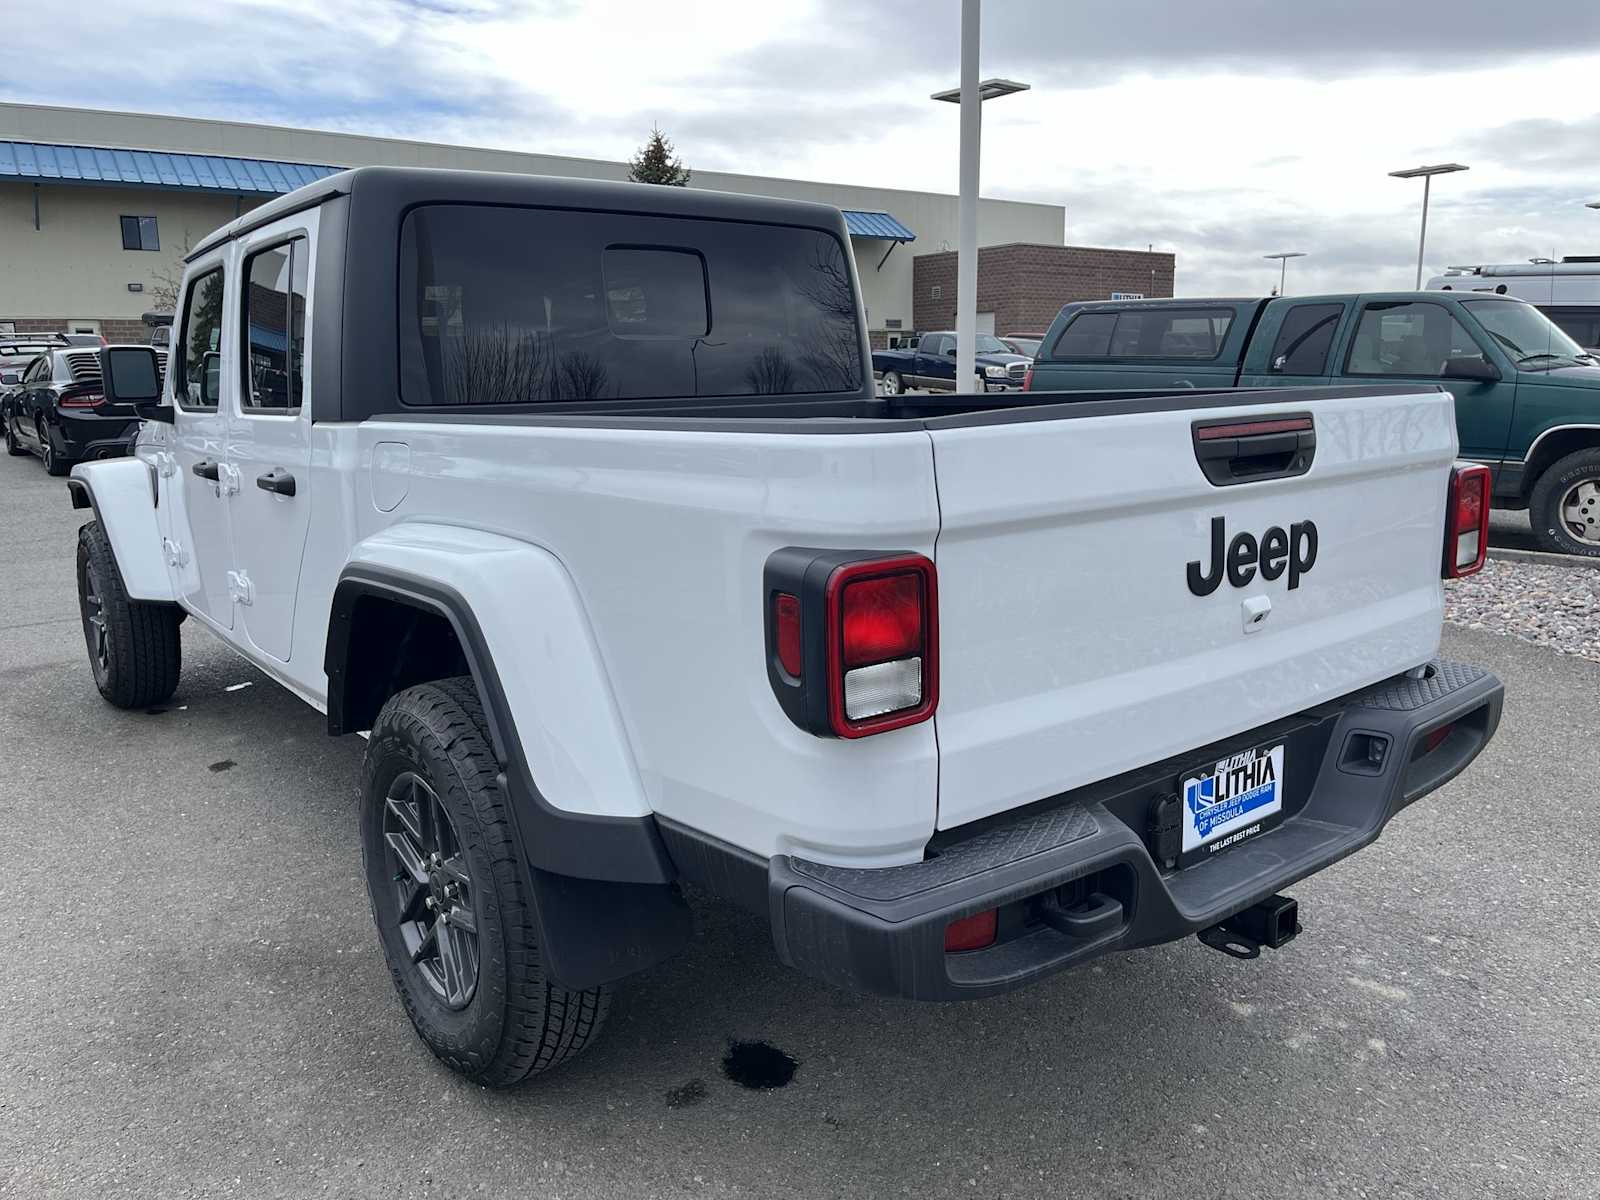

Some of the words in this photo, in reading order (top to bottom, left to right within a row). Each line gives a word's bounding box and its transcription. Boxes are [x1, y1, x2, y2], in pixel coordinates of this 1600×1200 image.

[1186, 516, 1318, 597] Jeep
[1224, 748, 1257, 771] LITHIA
[1215, 756, 1275, 803] LITHIA
[1199, 802, 1228, 820] CHRYSLER
[1228, 797, 1242, 809] JEEP
[1242, 790, 1260, 802] DODGE
[1260, 784, 1272, 794] RAM
[1199, 820, 1209, 832] OF
[1210, 805, 1243, 826] MISSOULA
[1209, 842, 1220, 853] THE
[1220, 835, 1233, 849] LAST
[1233, 829, 1246, 842] BEST
[1246, 824, 1260, 836] PRICE
